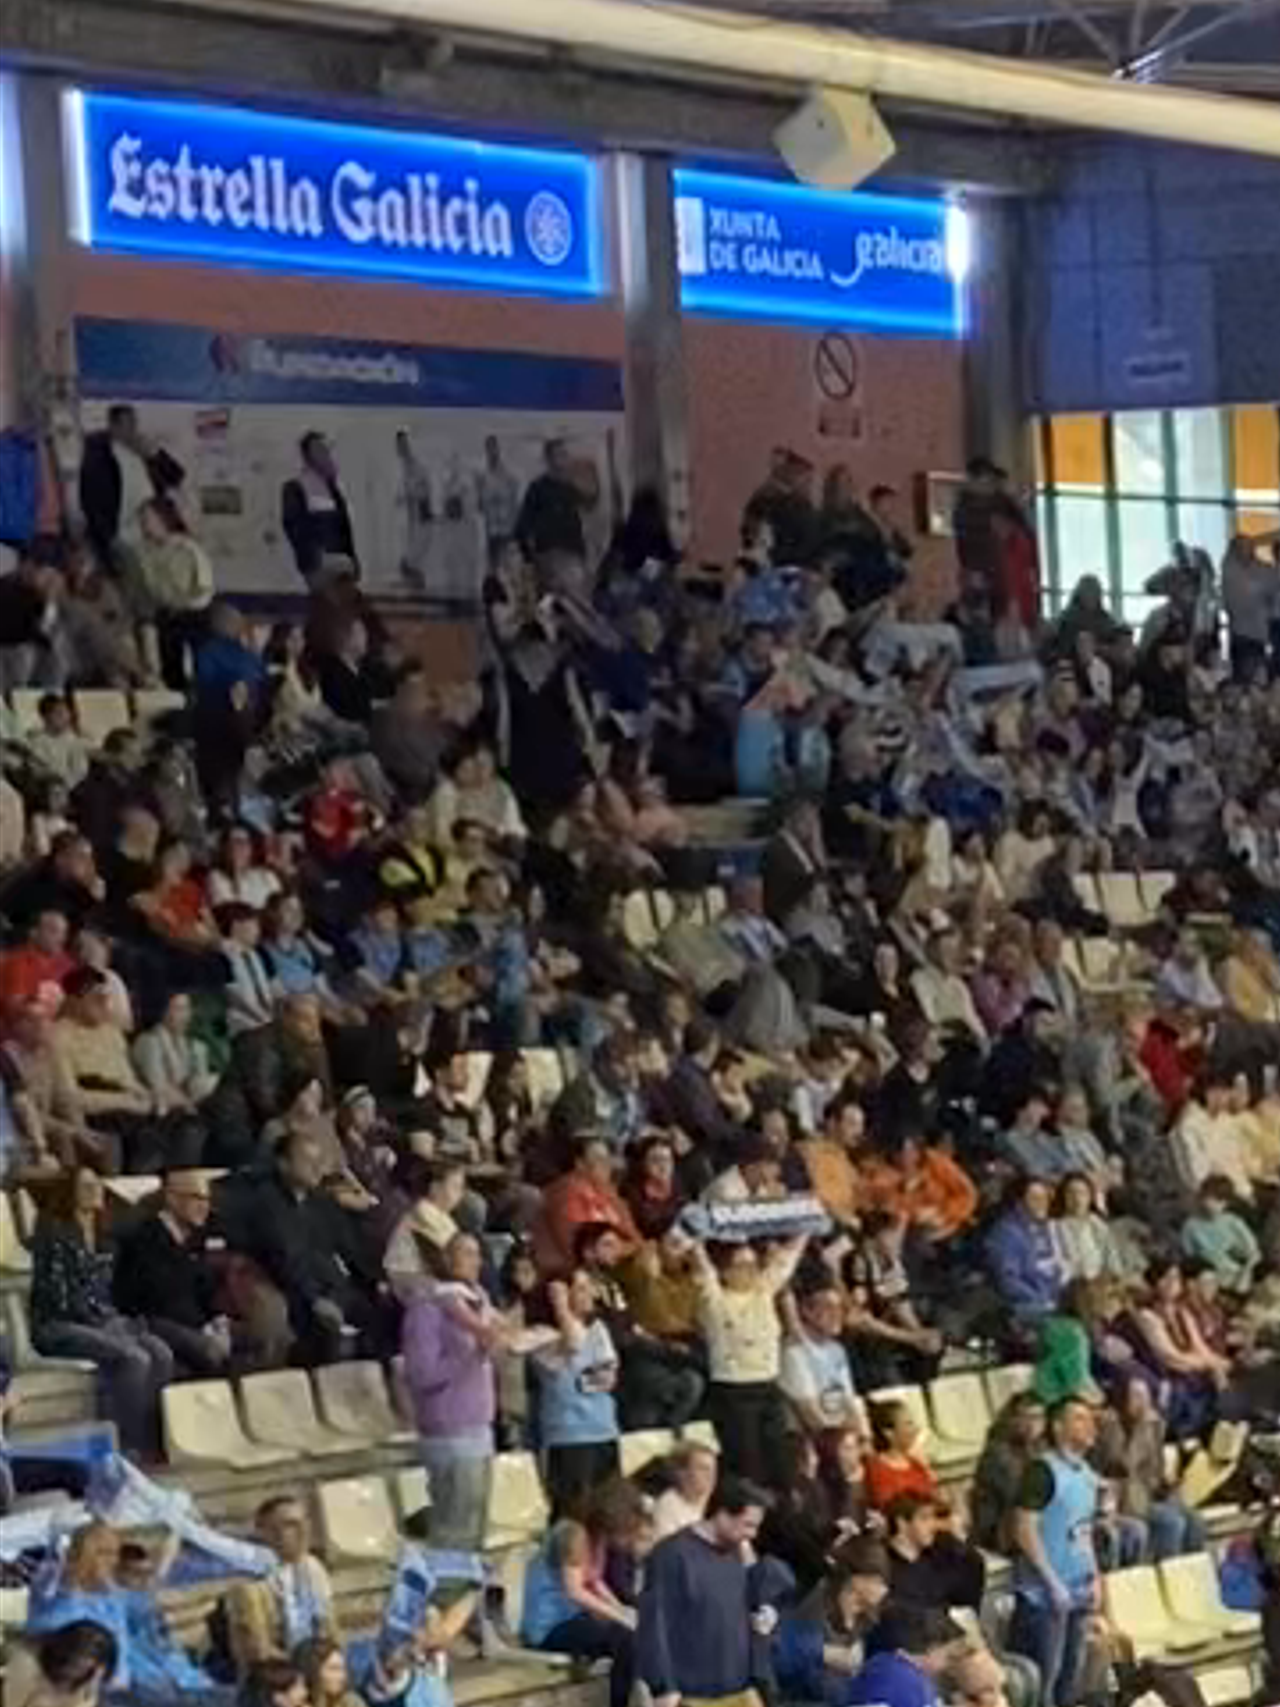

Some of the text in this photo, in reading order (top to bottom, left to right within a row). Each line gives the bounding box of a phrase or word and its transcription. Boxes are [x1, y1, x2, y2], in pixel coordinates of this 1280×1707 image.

[108, 133, 513, 258] Estrella Galicia
[709, 207, 782, 241] XUNTA
[709, 242, 824, 279] DE GALICIA
